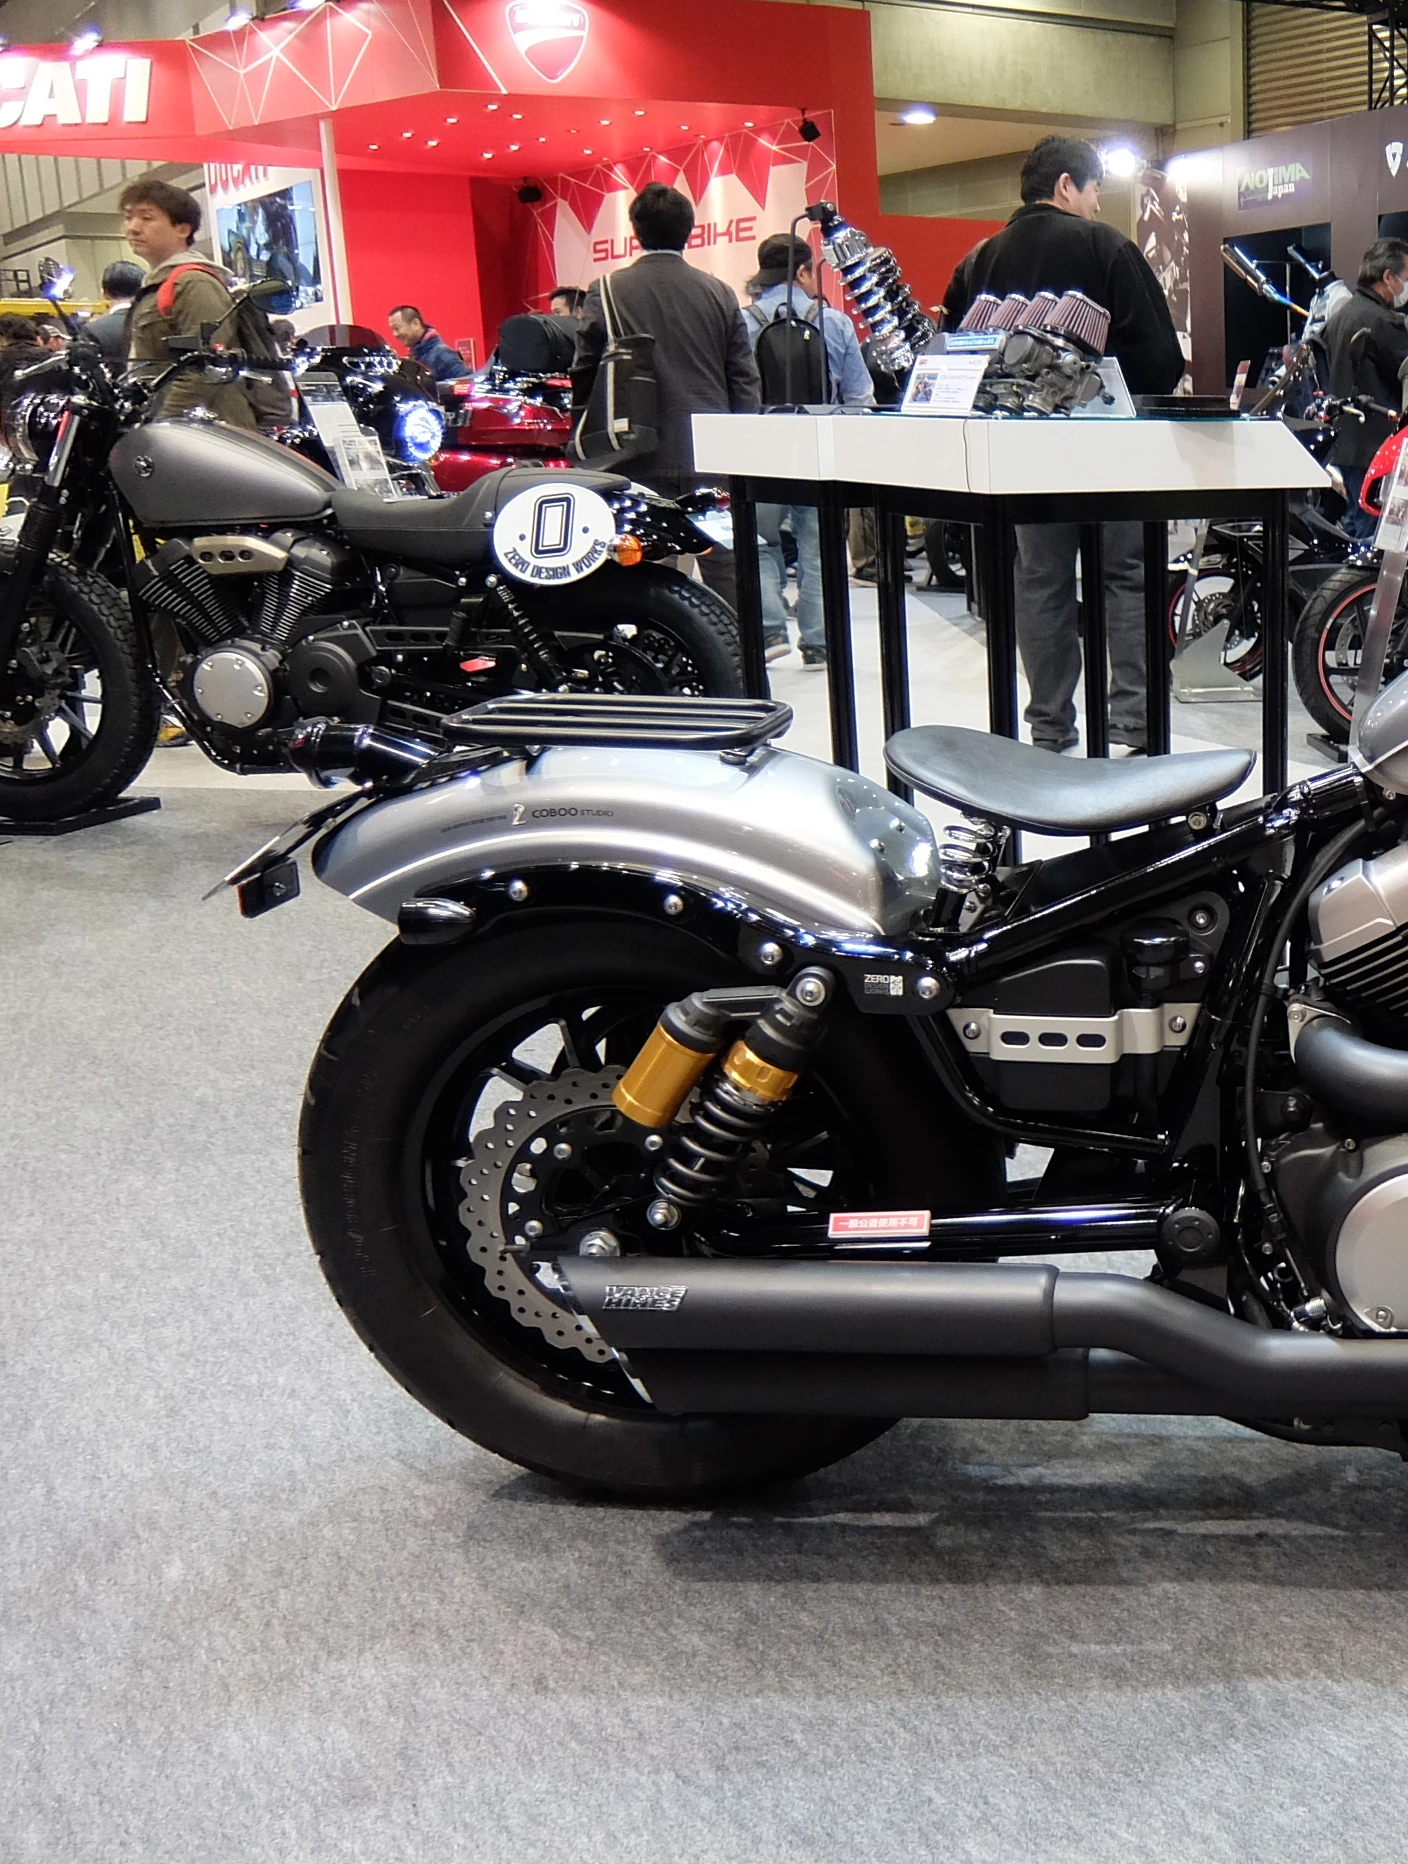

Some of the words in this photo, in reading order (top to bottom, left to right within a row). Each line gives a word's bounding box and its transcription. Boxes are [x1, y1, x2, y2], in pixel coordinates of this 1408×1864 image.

[593, 216, 756, 262] SUPBIKE
[504, 547, 530, 574] ZERO
[530, 565, 571, 580] DESIGN
[572, 538, 606, 574] WORKS
[532, 808, 578, 818] COBOO
[580, 810, 613, 818] STUDIO
[864, 974, 889, 983] ZERO
